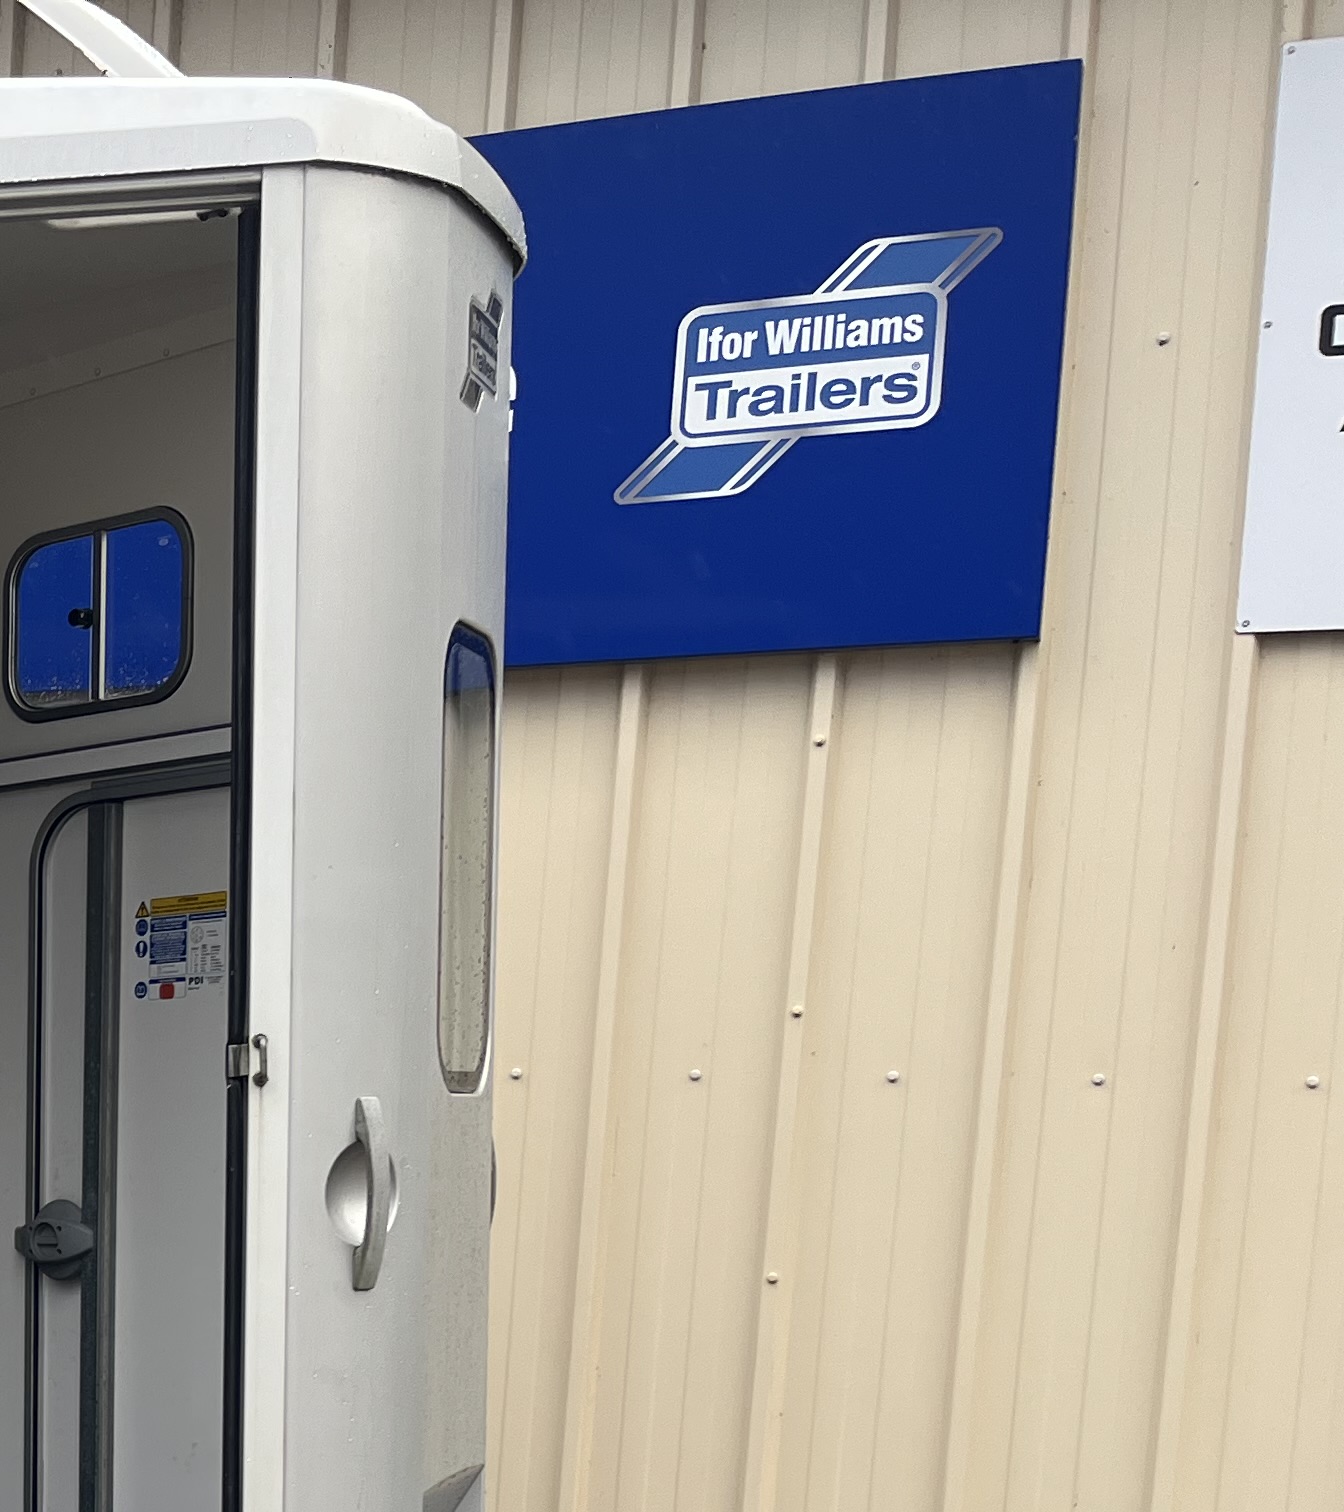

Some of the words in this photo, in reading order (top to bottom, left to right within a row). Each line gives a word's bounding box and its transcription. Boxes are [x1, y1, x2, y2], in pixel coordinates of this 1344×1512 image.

[696, 327, 758, 364] Ifor
[764, 312, 924, 356] Williams
[695, 371, 918, 421] Trailers
